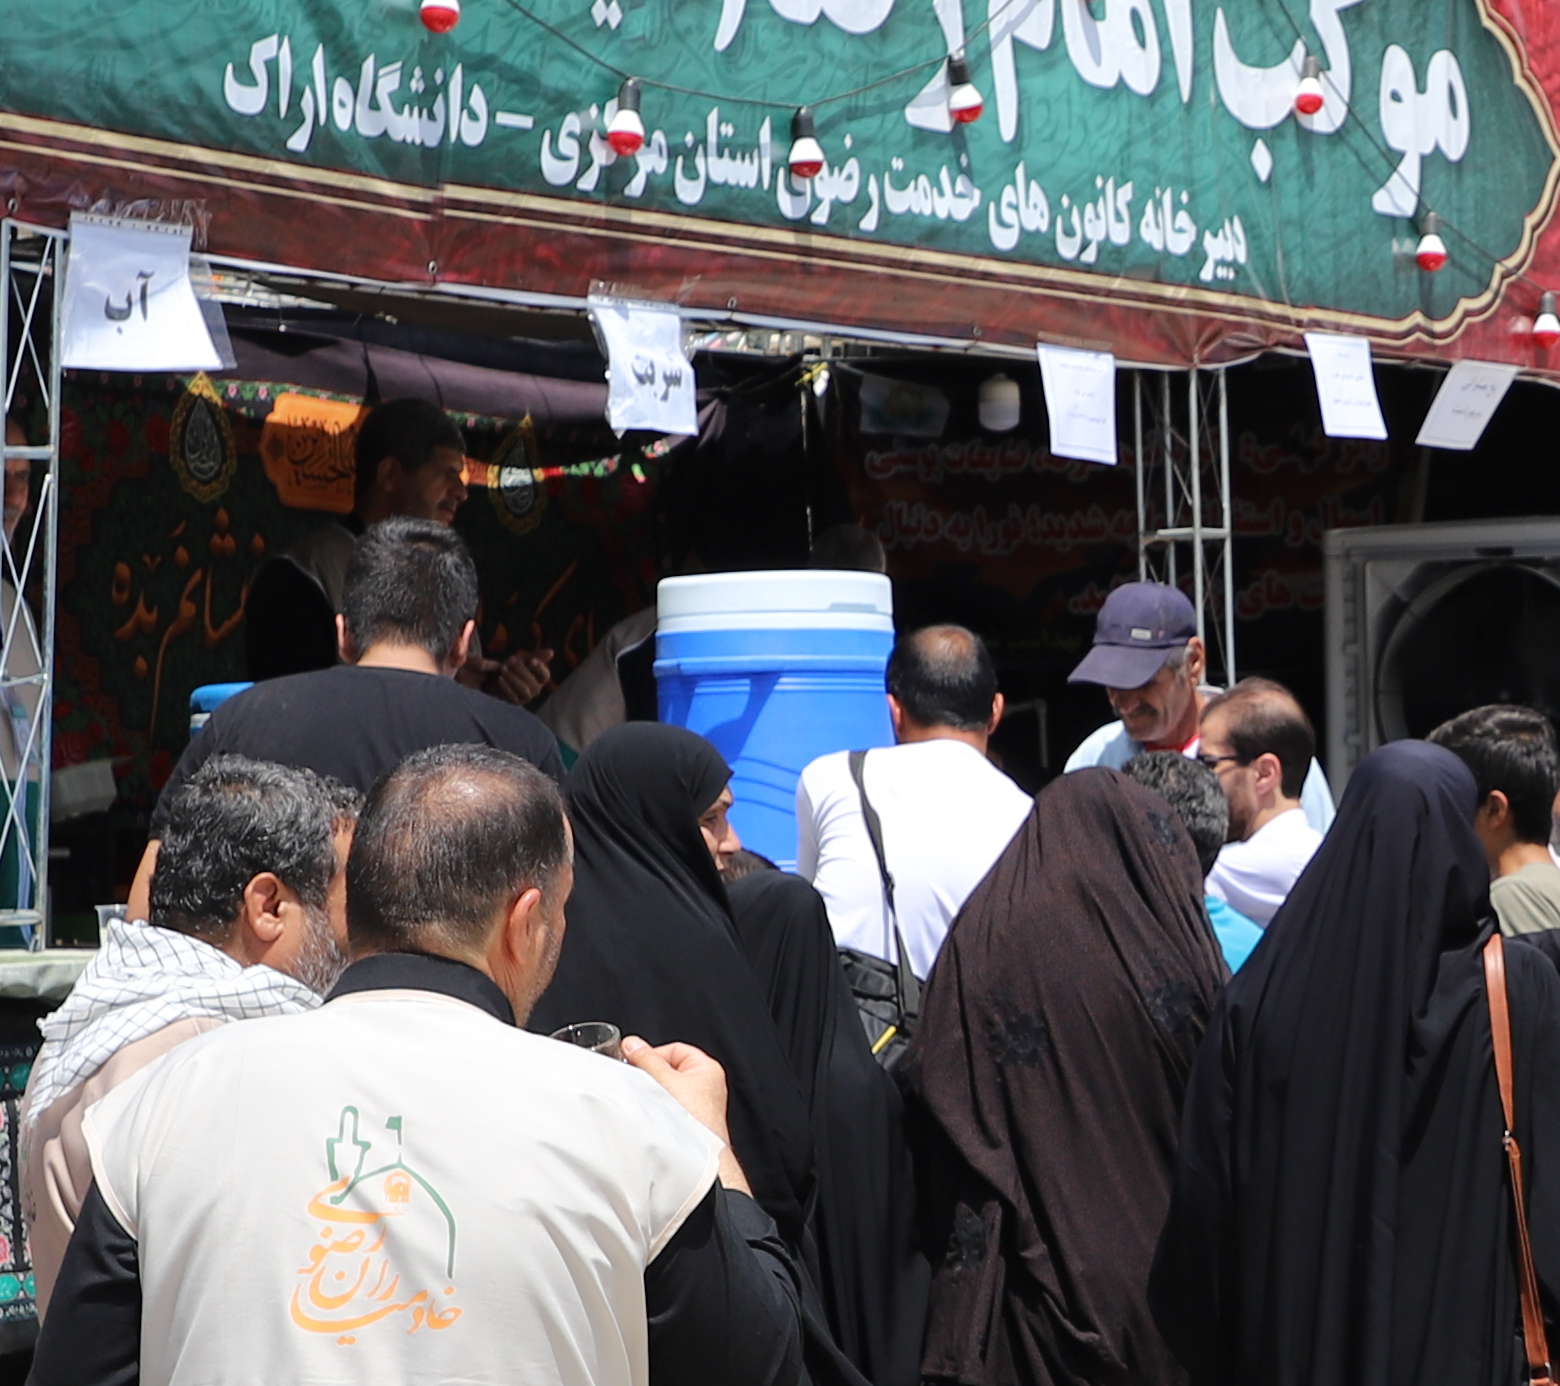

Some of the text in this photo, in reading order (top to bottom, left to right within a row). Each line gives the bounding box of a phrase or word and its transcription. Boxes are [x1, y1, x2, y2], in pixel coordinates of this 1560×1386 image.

[223, 33, 326, 153] اراک
[332, 51, 490, 149] دانشگاه
[672, 105, 772, 206] استان
[776, 133, 880, 232] رضوی
[883, 153, 981, 221] خدمت
[987, 160, 1051, 252] های
[1055, 175, 1134, 264] کانون
[1139, 186, 1197, 256] خانه
[103, 289, 151, 342] آب
